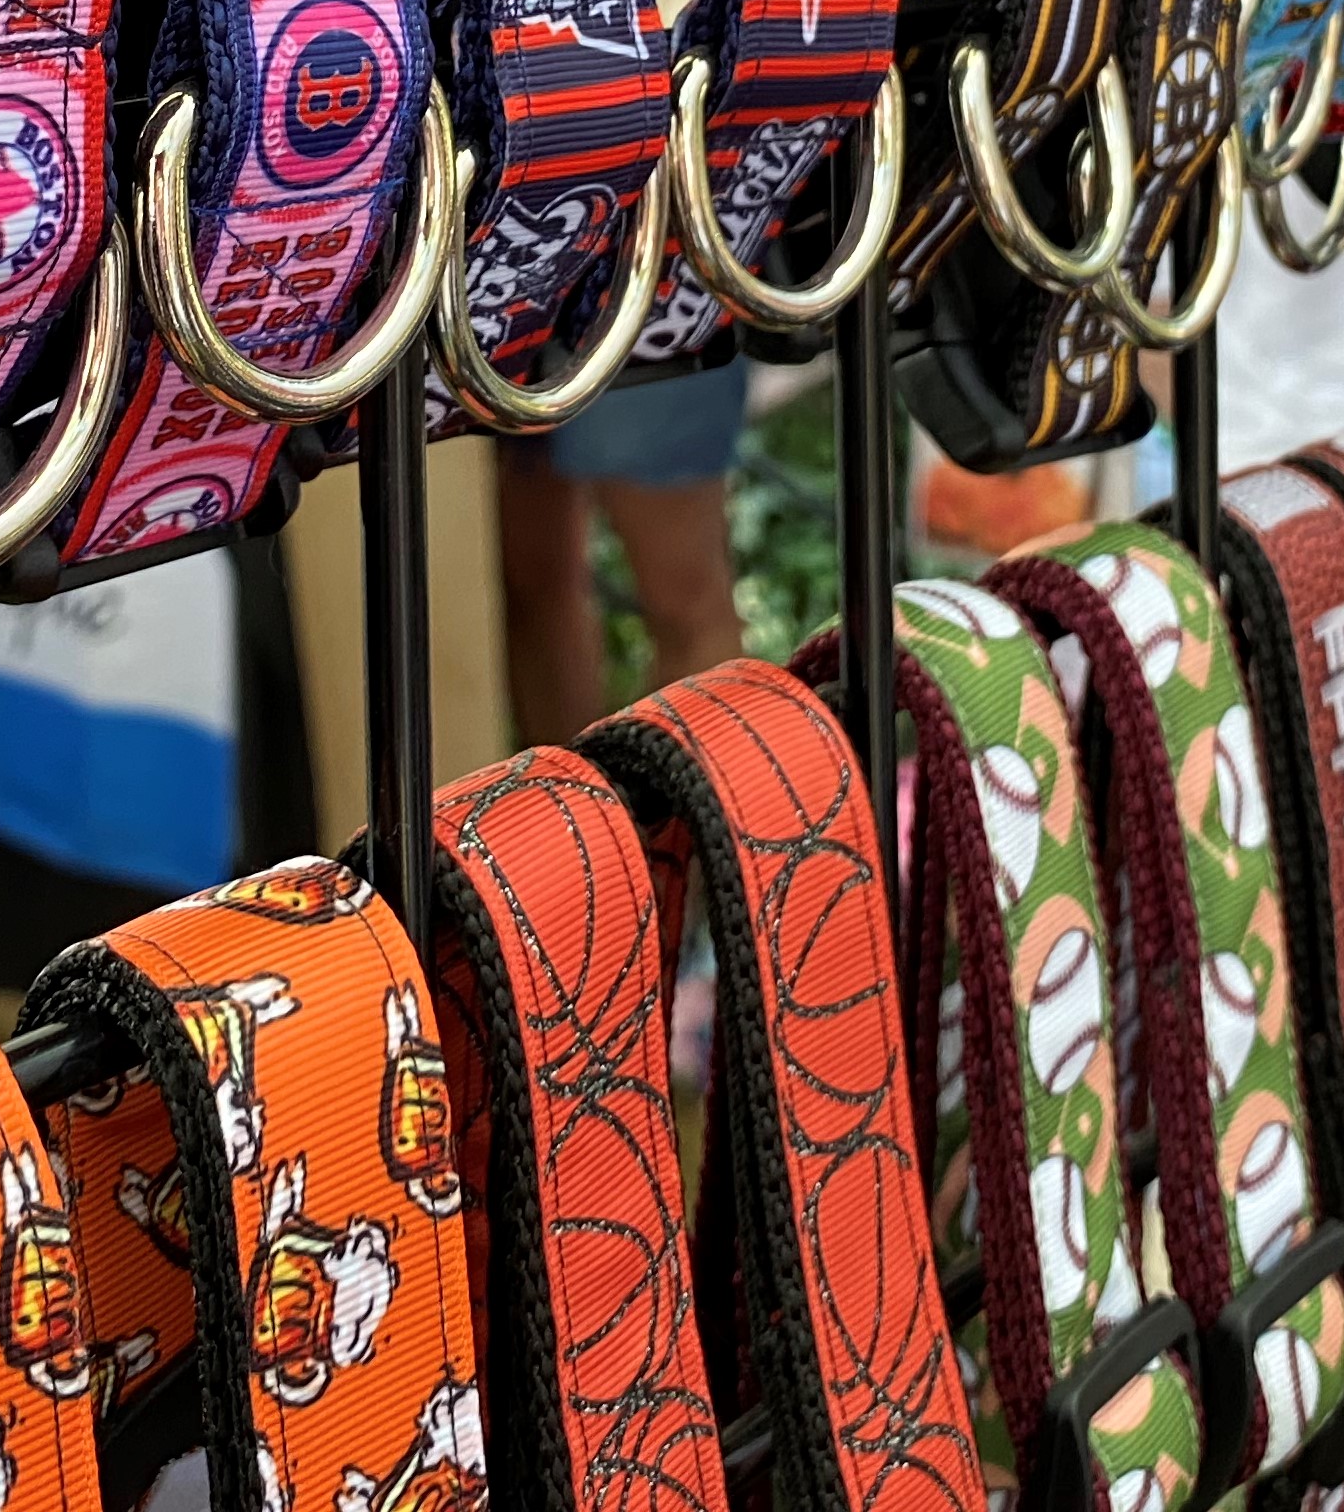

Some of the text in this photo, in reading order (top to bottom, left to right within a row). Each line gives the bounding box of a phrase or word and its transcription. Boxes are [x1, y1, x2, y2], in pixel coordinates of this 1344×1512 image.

[262, 32, 300, 159] RED SOX
[295, 54, 376, 133] B
[359, 27, 400, 150] BOSTON
[11, 115, 65, 278] BOSTON
